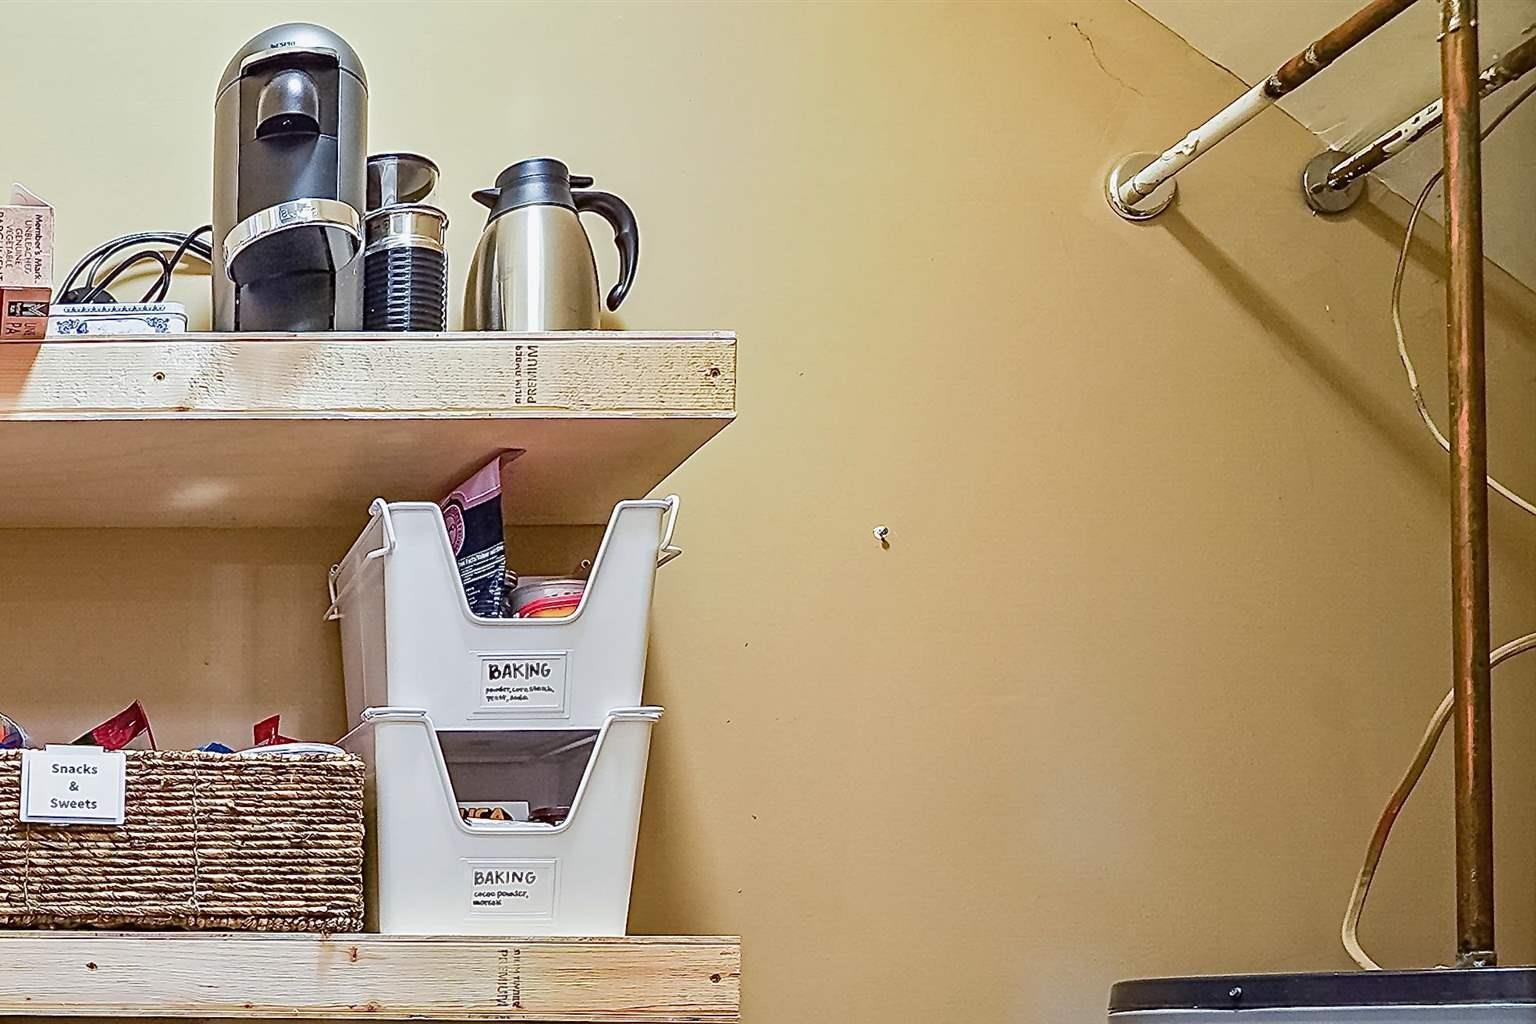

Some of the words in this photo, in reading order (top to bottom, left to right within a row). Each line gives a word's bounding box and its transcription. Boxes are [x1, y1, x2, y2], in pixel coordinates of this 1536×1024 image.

[35, 215, 43, 254] Member's
[15, 228, 23, 265] GENUINE
[527, 346, 538, 403] PREMIUM
[488, 662, 551, 680] BAKING
[52, 764, 98, 774] Snacks
[69, 781, 79, 791] &
[50, 798, 97, 809] Sweets
[474, 870, 536, 885] BAKING
